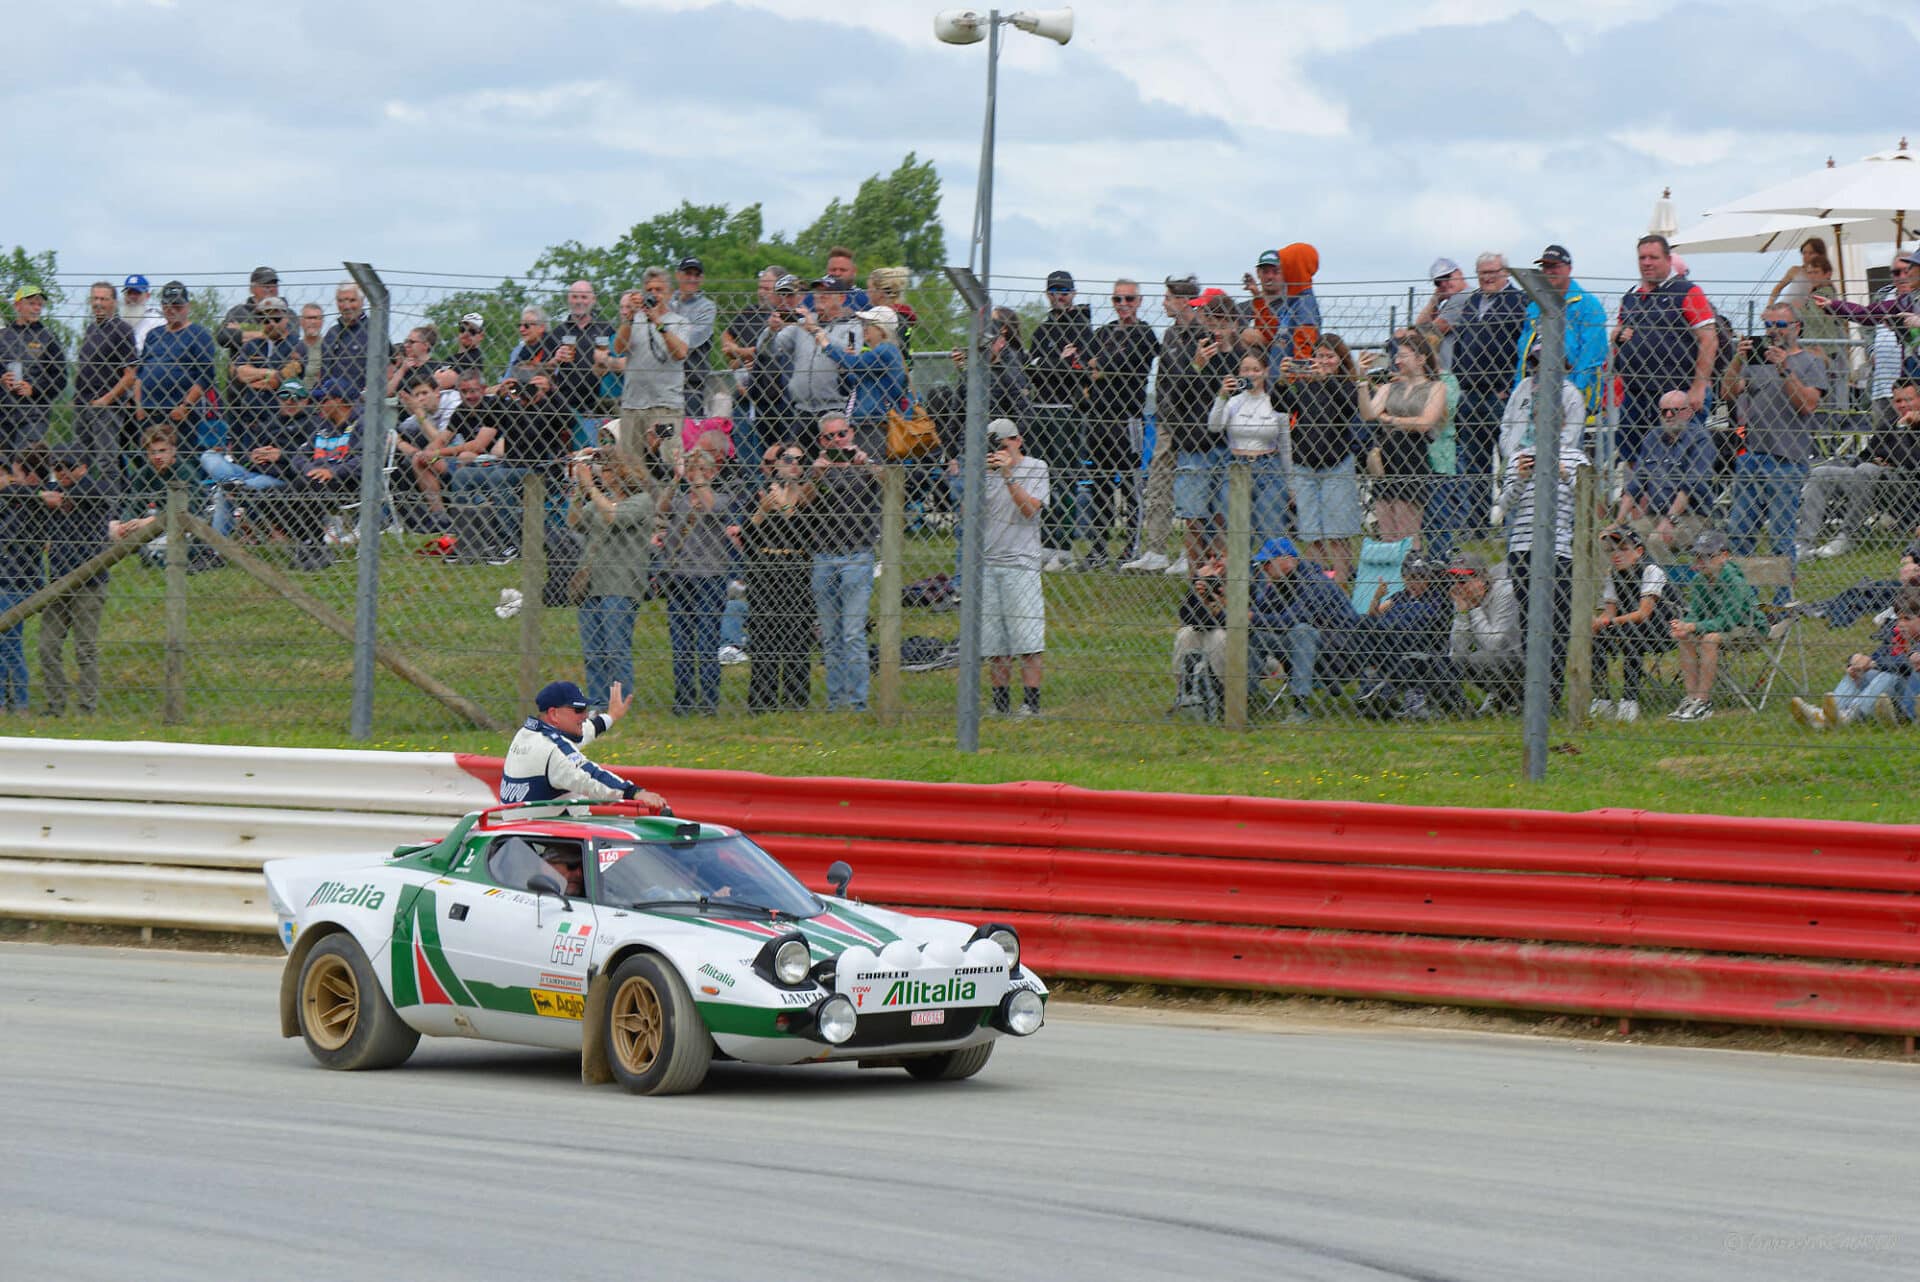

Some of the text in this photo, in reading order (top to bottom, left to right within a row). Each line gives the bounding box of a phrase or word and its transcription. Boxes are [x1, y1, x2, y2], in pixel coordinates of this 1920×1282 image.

[305, 881, 385, 910] Alitalia
[698, 963, 736, 988] Alitalia
[856, 970, 910, 980] CARELLO
[954, 965, 1004, 976] CARELLO
[881, 978, 977, 1006] Alitalia
